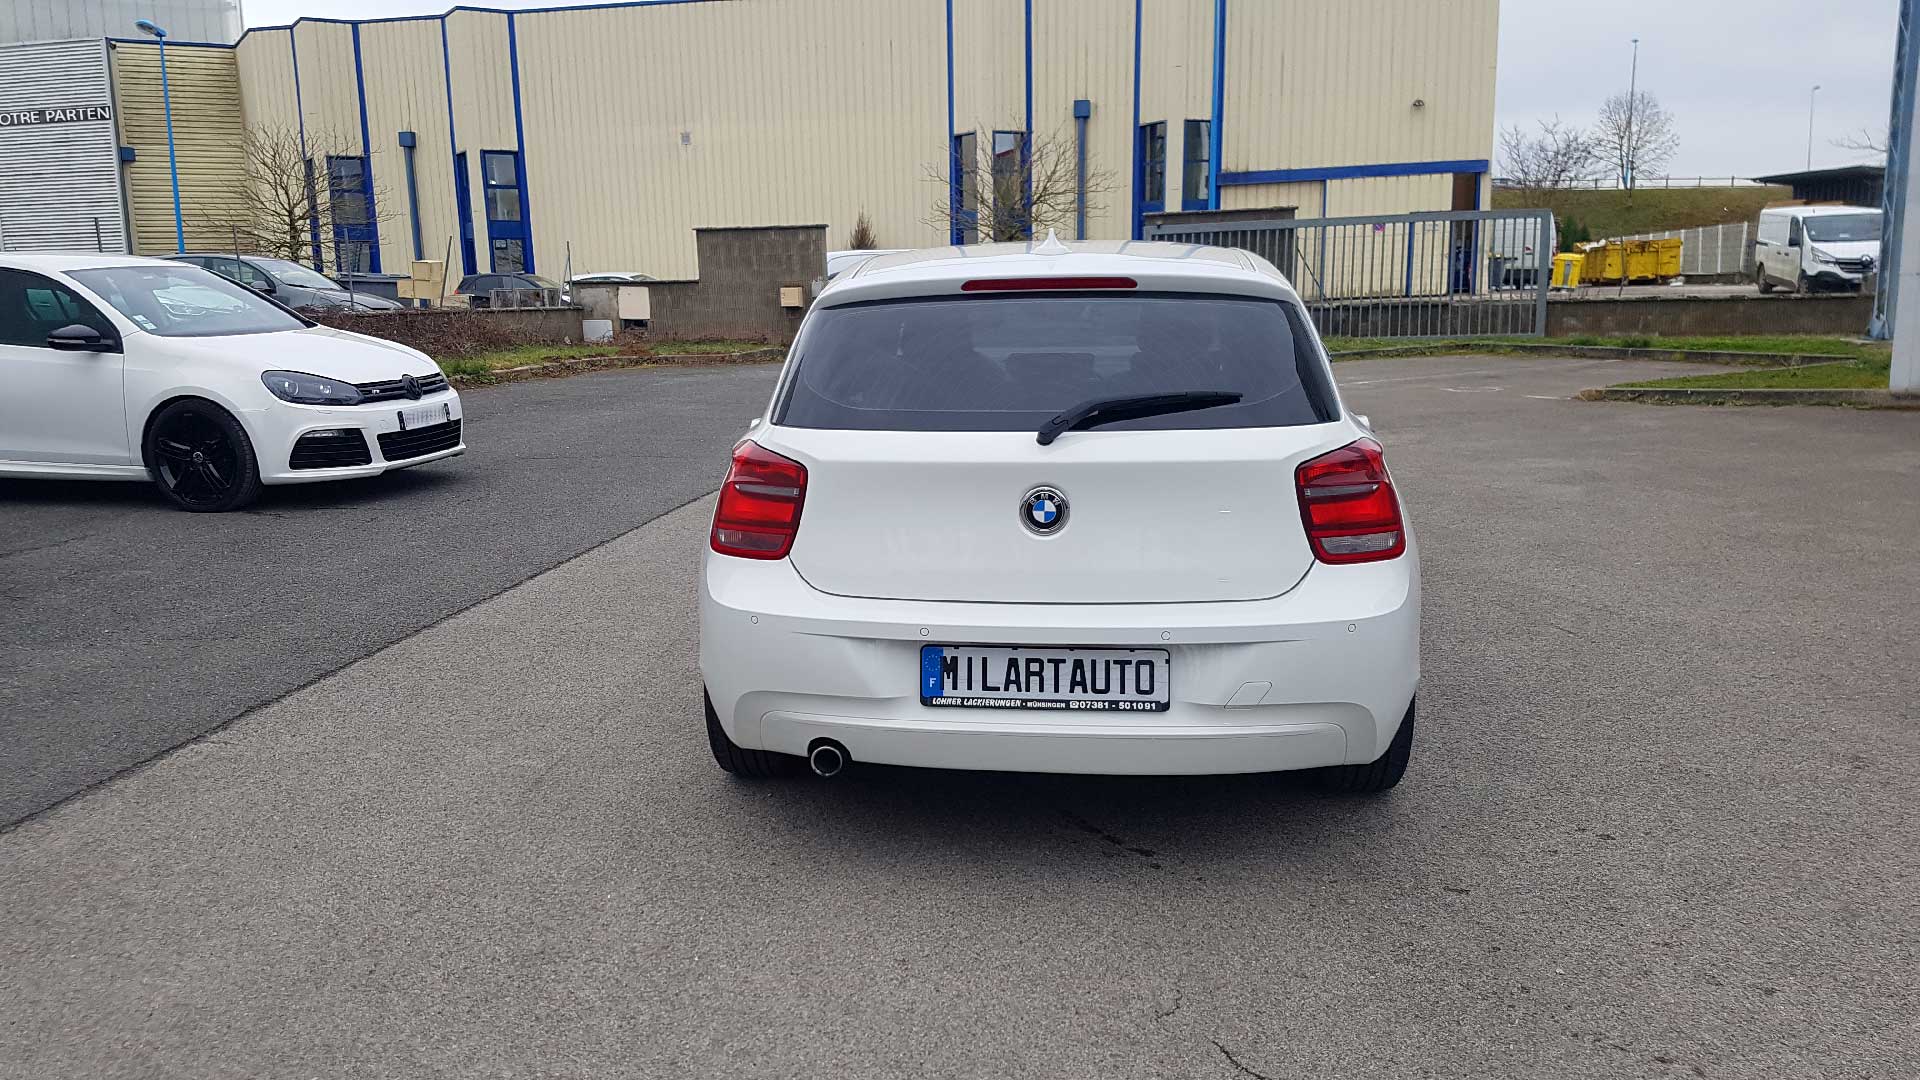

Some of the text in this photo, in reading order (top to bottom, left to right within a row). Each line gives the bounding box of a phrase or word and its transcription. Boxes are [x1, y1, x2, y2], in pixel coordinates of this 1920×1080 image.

[45, 107, 110, 122] PARTEN
[940, 655, 1155, 695] MILARTAUTO
[929, 678, 937, 688] F
[964, 698, 1022, 708] LACKIERUNGEN
[1079, 701, 1109, 709] 07381
